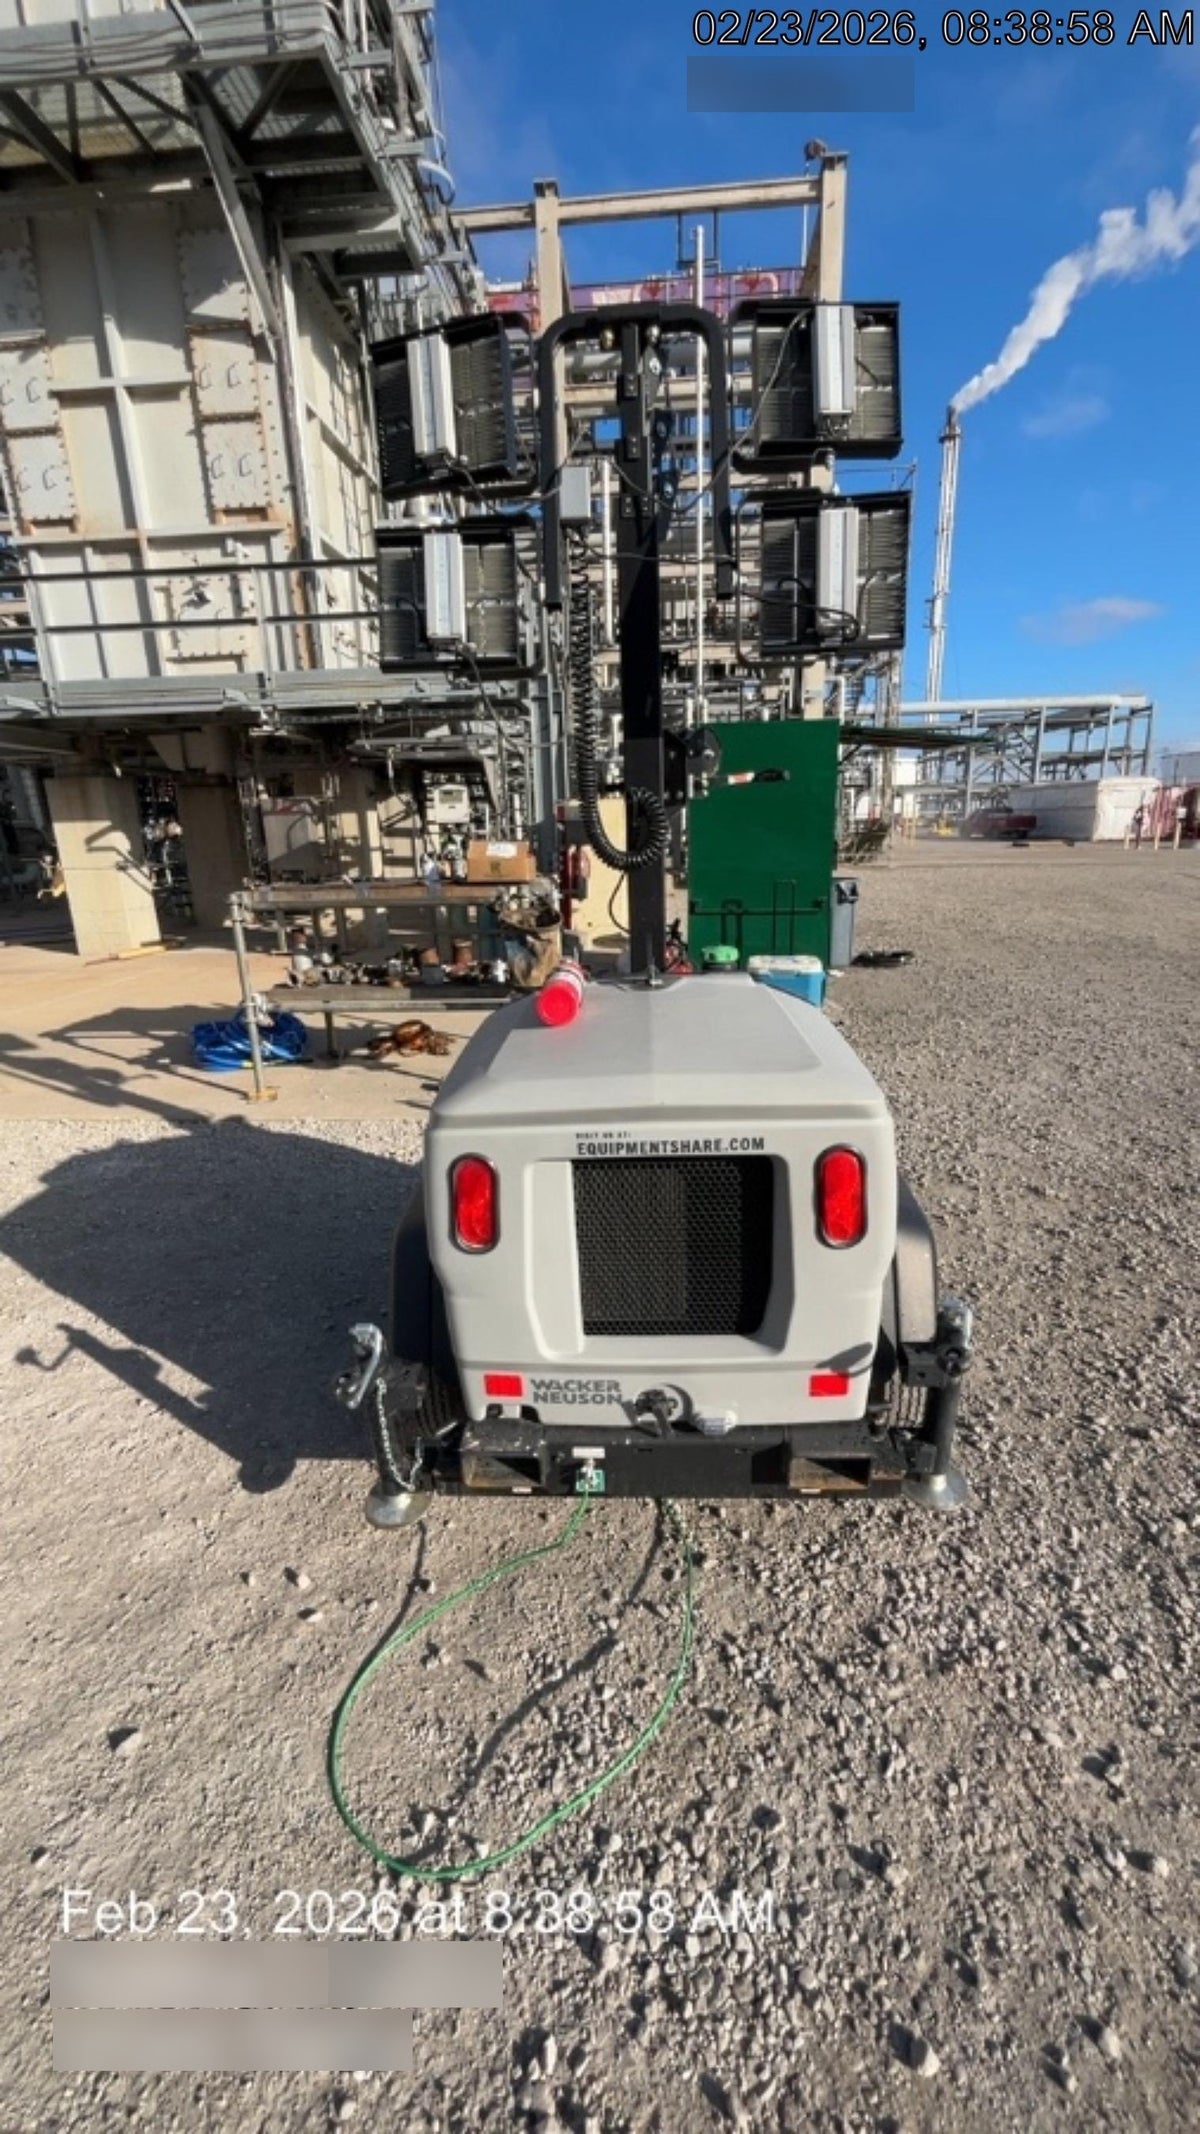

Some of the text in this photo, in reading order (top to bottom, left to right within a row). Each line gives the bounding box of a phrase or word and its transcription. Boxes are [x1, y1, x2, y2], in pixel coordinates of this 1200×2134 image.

[577, 1137, 765, 1156] EQUIPMENTSHARE.COM
[531, 1379, 621, 1392] WACKER
[533, 1391, 623, 1405] NEUSON
